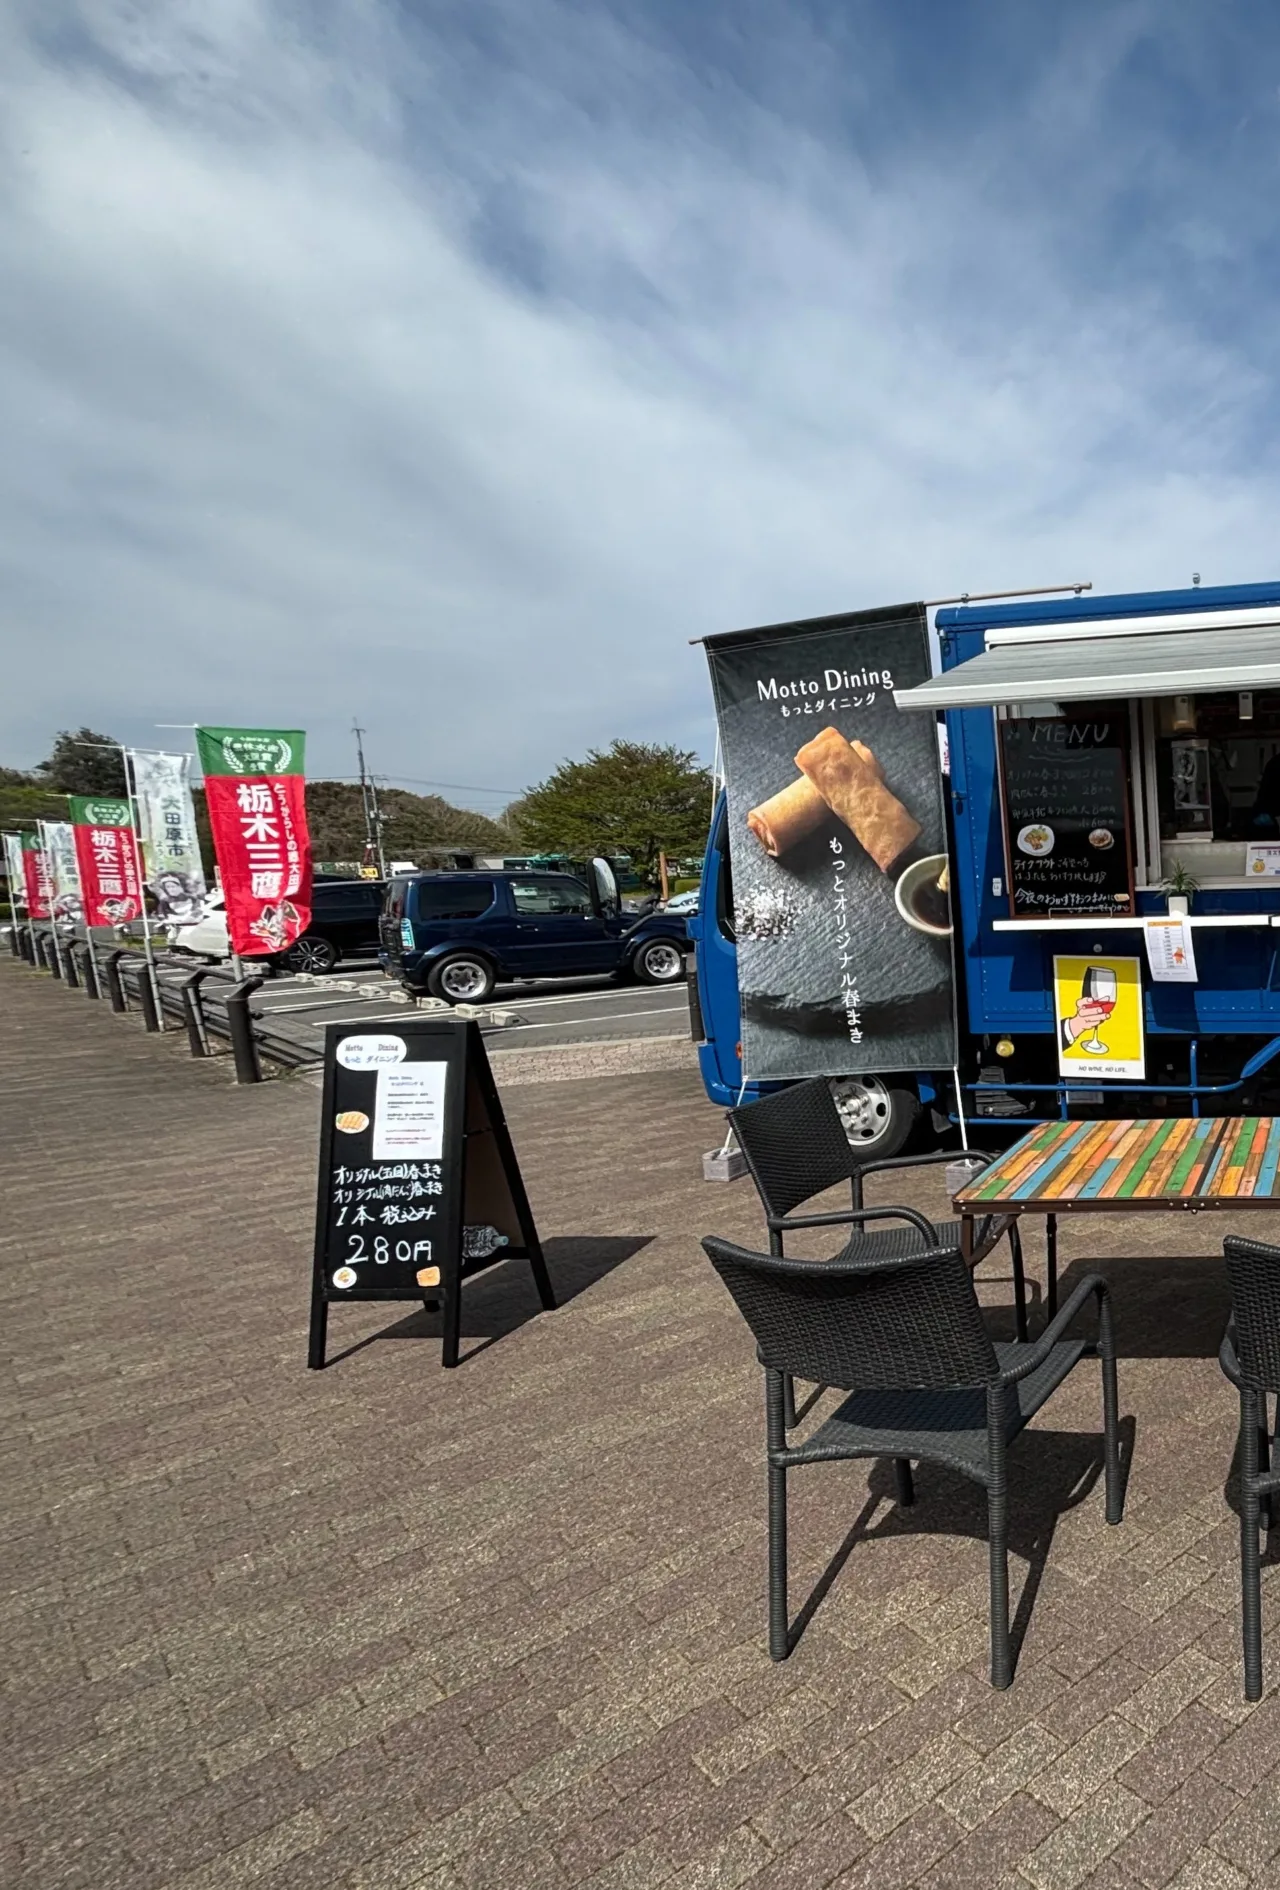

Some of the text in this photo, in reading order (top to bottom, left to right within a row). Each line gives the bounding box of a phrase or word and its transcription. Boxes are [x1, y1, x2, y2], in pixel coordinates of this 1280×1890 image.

[756, 667, 894, 700] Motto Dining
[780, 692, 876, 717] もっとダイニング
[1032, 723, 1110, 744] MENU
[236, 784, 283, 898] 栃木三鷹
[91, 830, 124, 895] 栃木三鷹
[829, 837, 864, 1044] もっとオリジナル春まき
[366, 1055, 399, 1063] ダイニング
[378, 1044, 399, 1052] Dining
[345, 1235, 432, 1264] 280円
